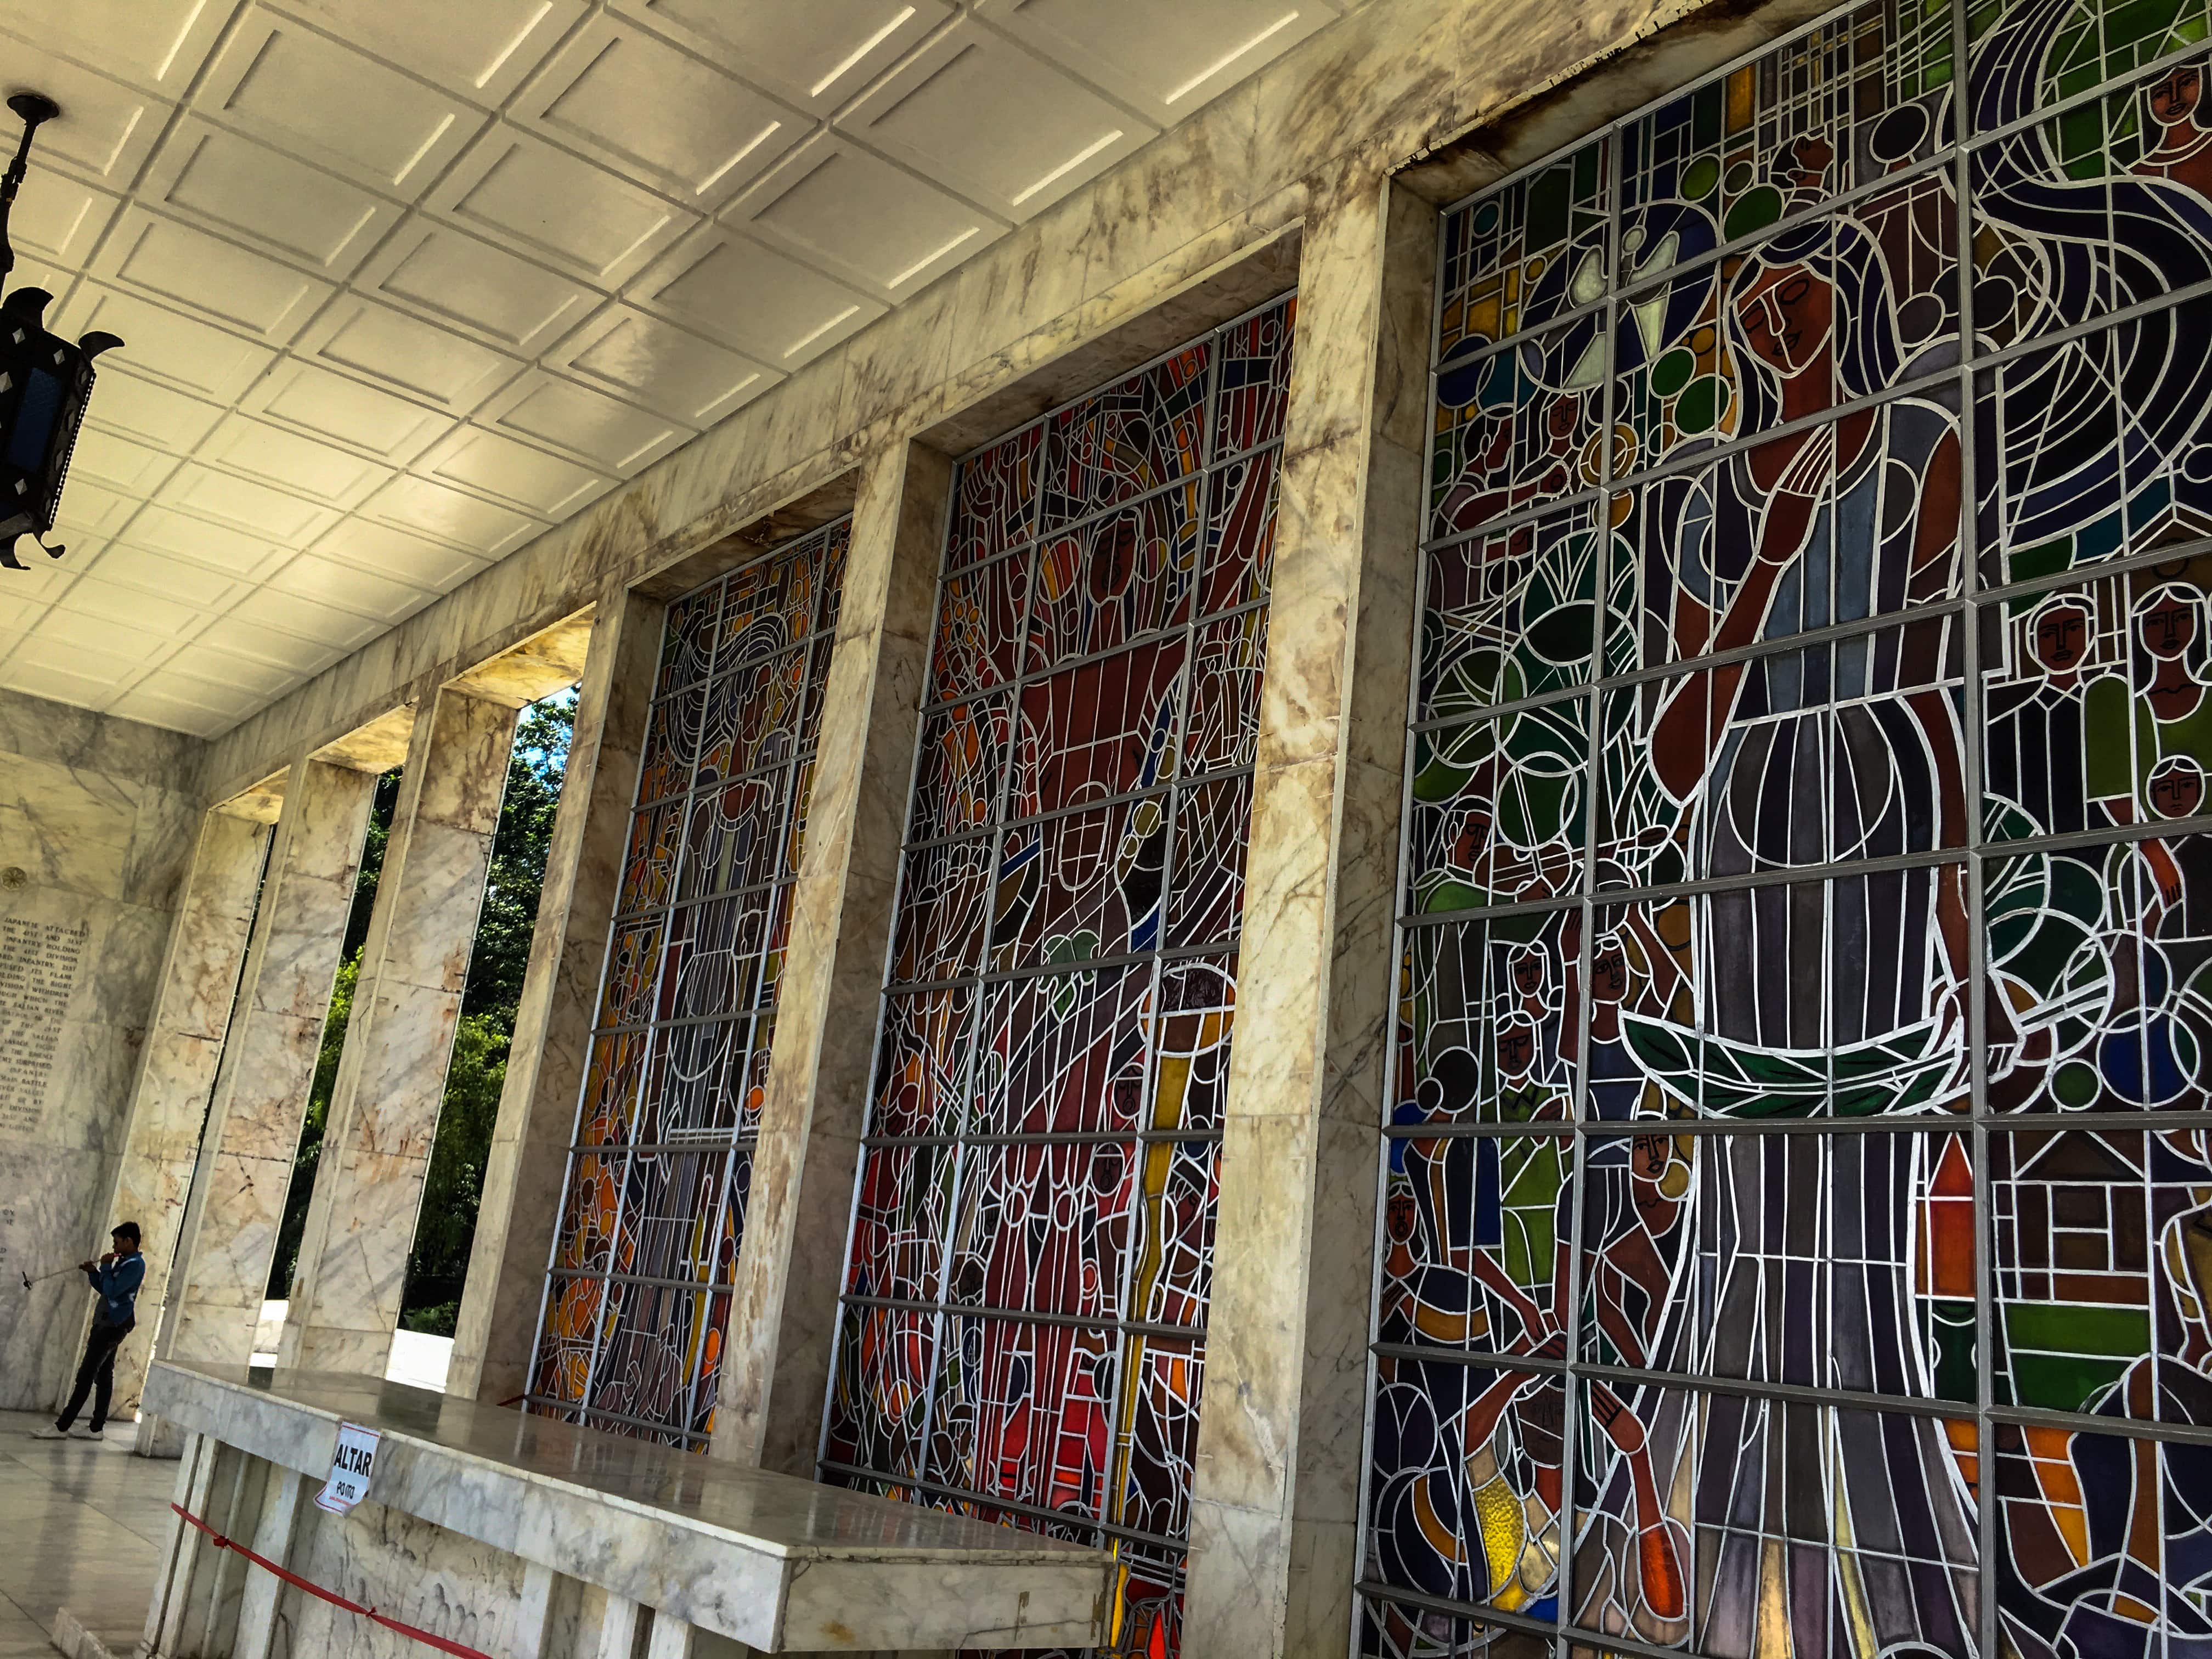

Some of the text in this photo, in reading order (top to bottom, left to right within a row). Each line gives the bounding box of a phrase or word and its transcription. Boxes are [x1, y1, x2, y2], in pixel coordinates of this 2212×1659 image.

[4, 917, 38, 928] JAPANESE
[6, 936, 80, 954] INFANTRY HOLDING
[334, 1444, 372, 1477] ALTAR
